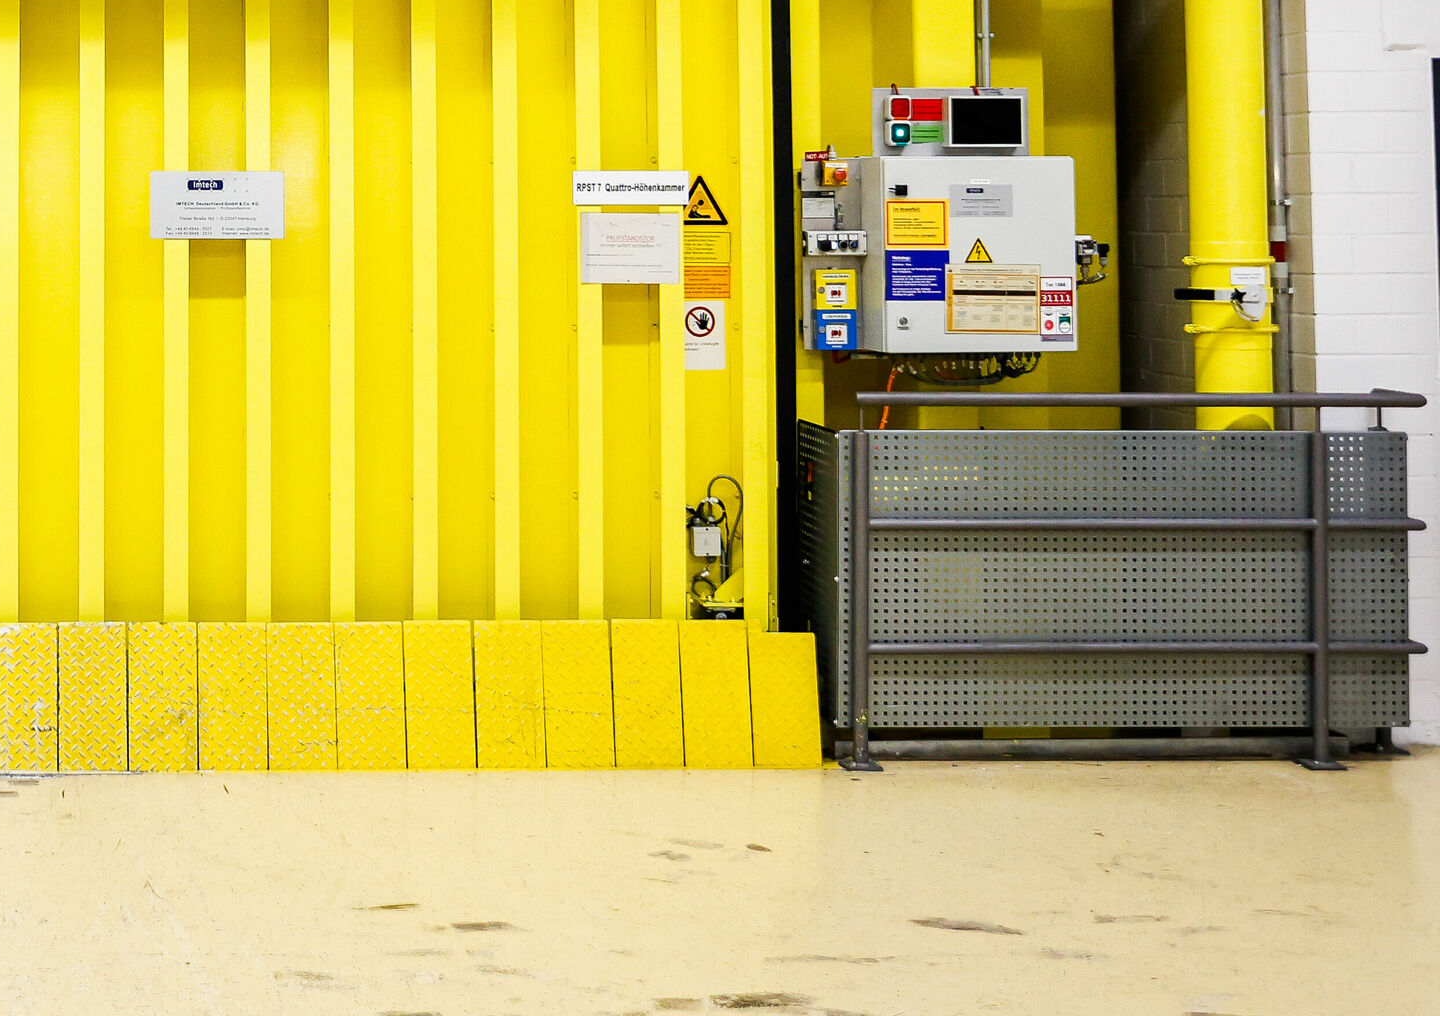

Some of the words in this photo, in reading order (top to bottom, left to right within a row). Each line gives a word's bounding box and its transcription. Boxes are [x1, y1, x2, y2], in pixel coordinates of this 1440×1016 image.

[193, 181, 218, 189] Imtech
[576, 183, 596, 192] RPST
[597, 183, 602, 192] 7
[604, 182, 685, 193] Quattro-Höhenkammer
[1040, 294, 1071, 303] 31111
